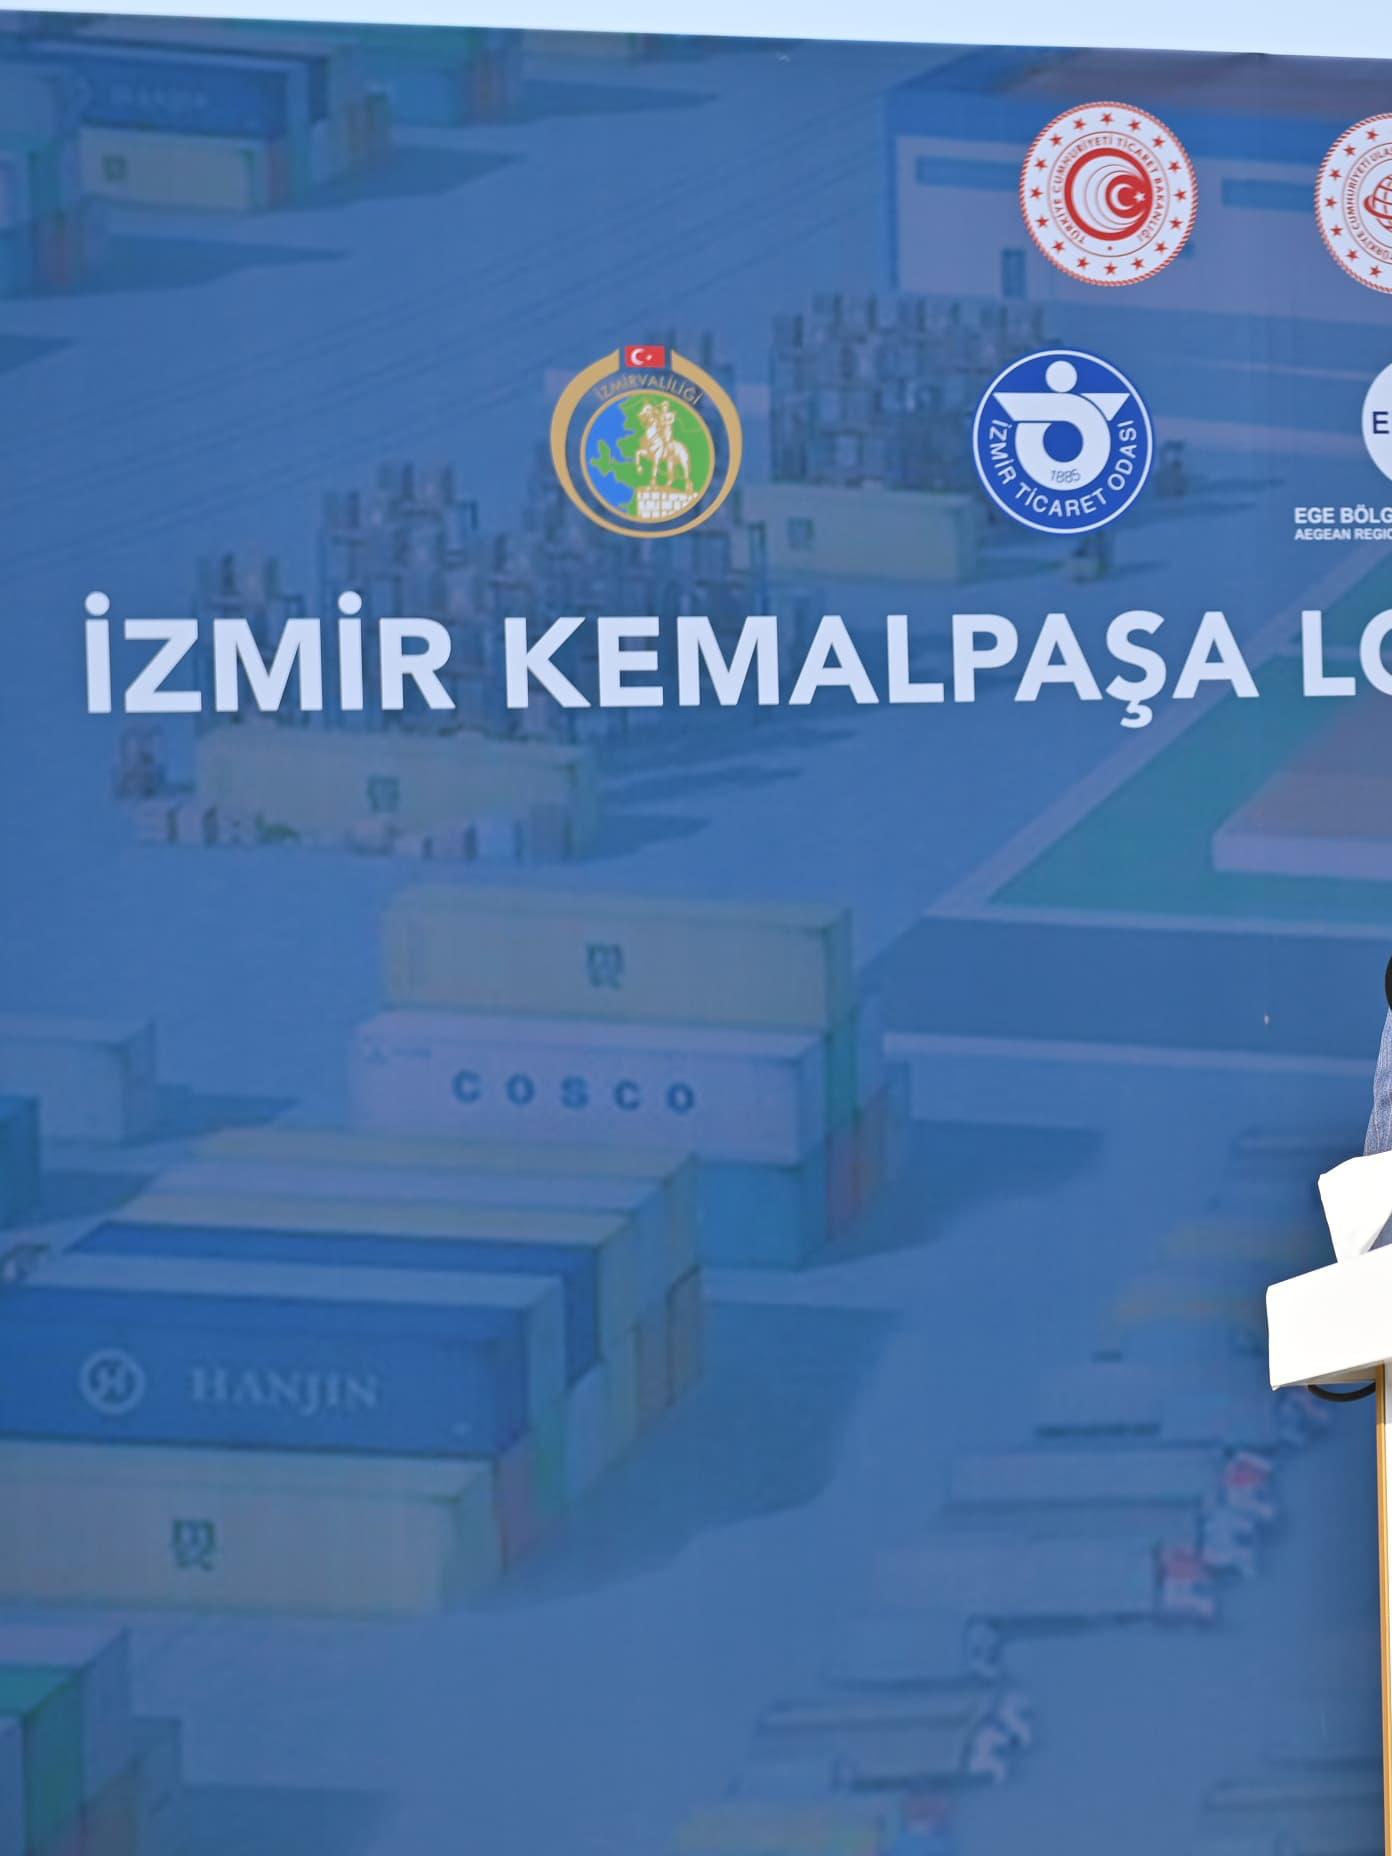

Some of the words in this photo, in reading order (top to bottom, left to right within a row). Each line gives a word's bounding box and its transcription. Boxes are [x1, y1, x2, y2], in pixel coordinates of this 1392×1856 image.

[1117, 136, 1158, 173] TİCARET
[989, 419, 1017, 485] İZMİR
[1015, 482, 1107, 518] TİCARET
[1107, 420, 1138, 491] ODASI
[1050, 468, 1081, 484] 1885
[1294, 506, 1336, 524] EGE
[1294, 527, 1352, 540] AEGEAN
[85, 590, 456, 713] İZMİR
[504, 610, 1261, 728] KEMALPAŞA
[451, 1068, 696, 1115] COSCO
[192, 1366, 379, 1416] HANJIN
